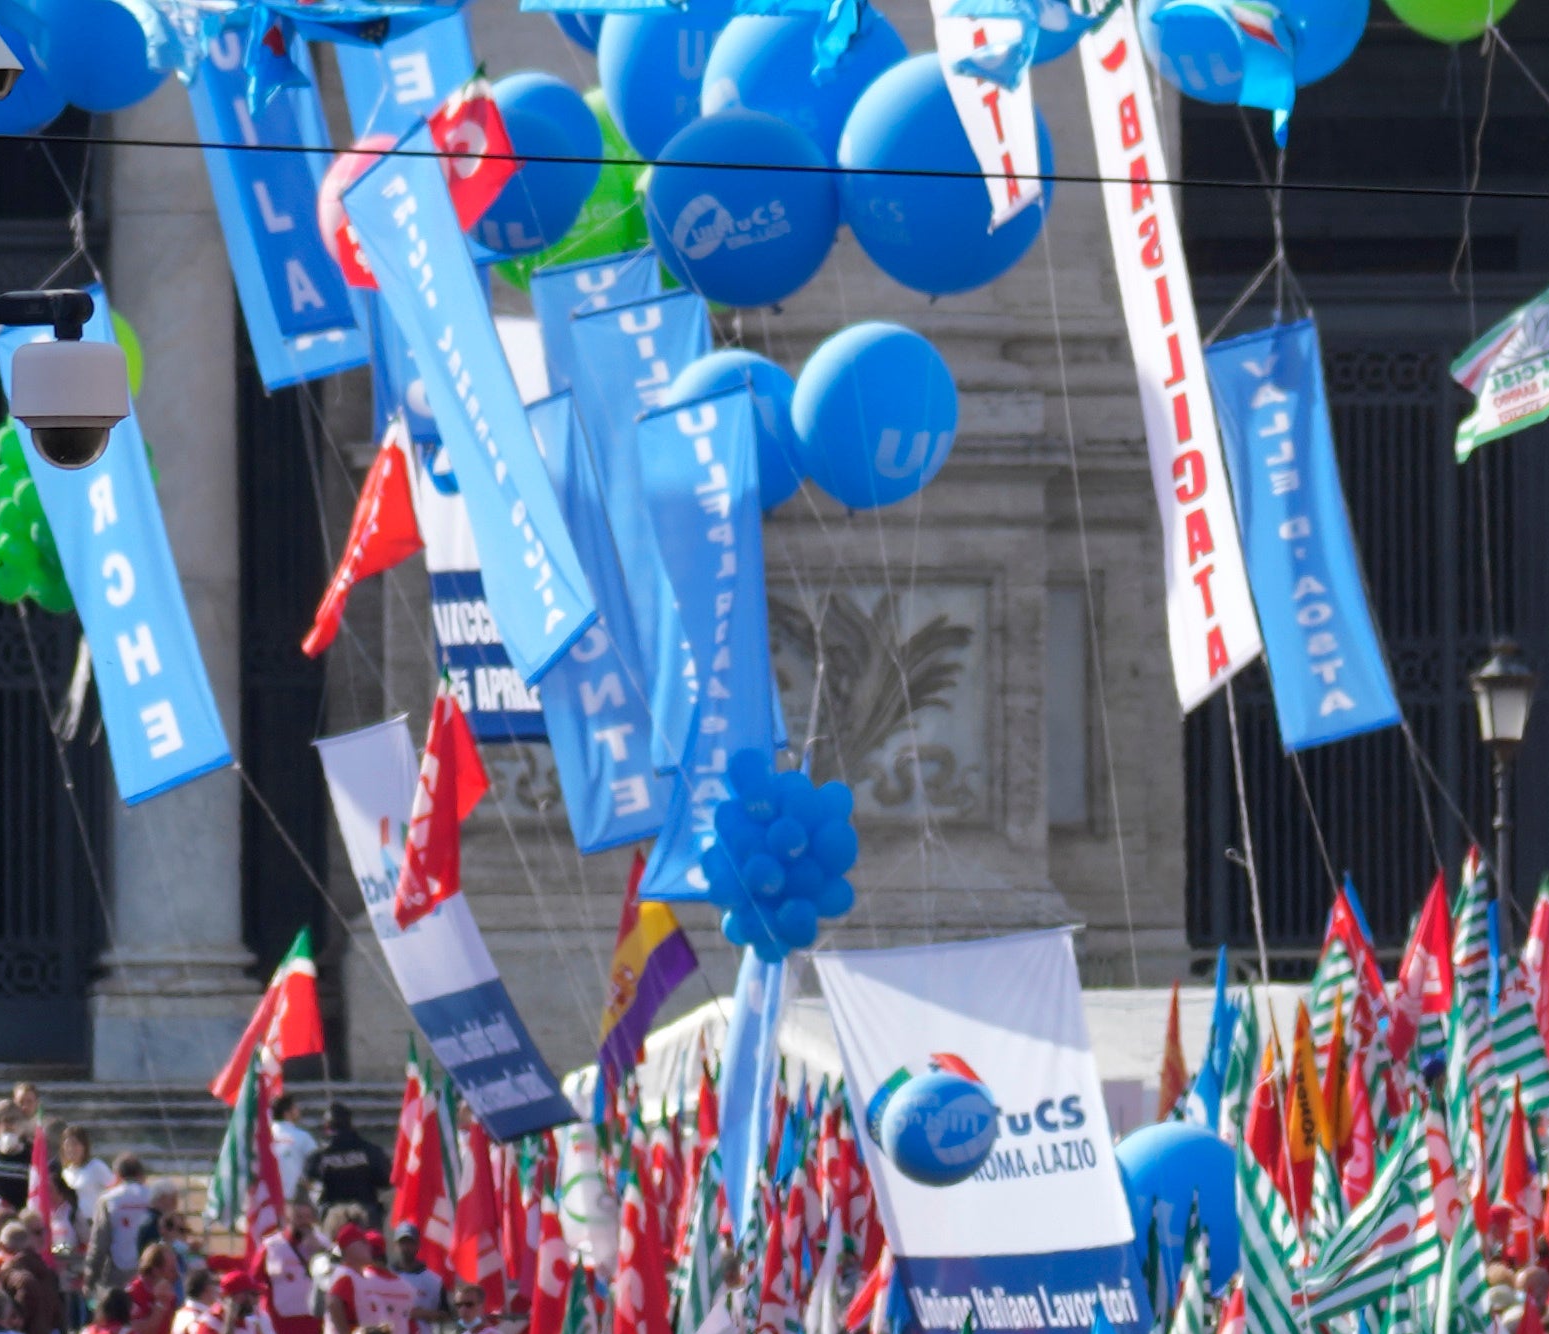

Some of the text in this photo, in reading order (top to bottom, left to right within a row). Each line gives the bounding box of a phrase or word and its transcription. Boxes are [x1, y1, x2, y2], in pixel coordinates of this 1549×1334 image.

[1040, 1140, 1098, 1178] LAZIO
[974, 1282, 1044, 1330] Italiana
[1045, 1277, 1137, 1328] Lavortori
